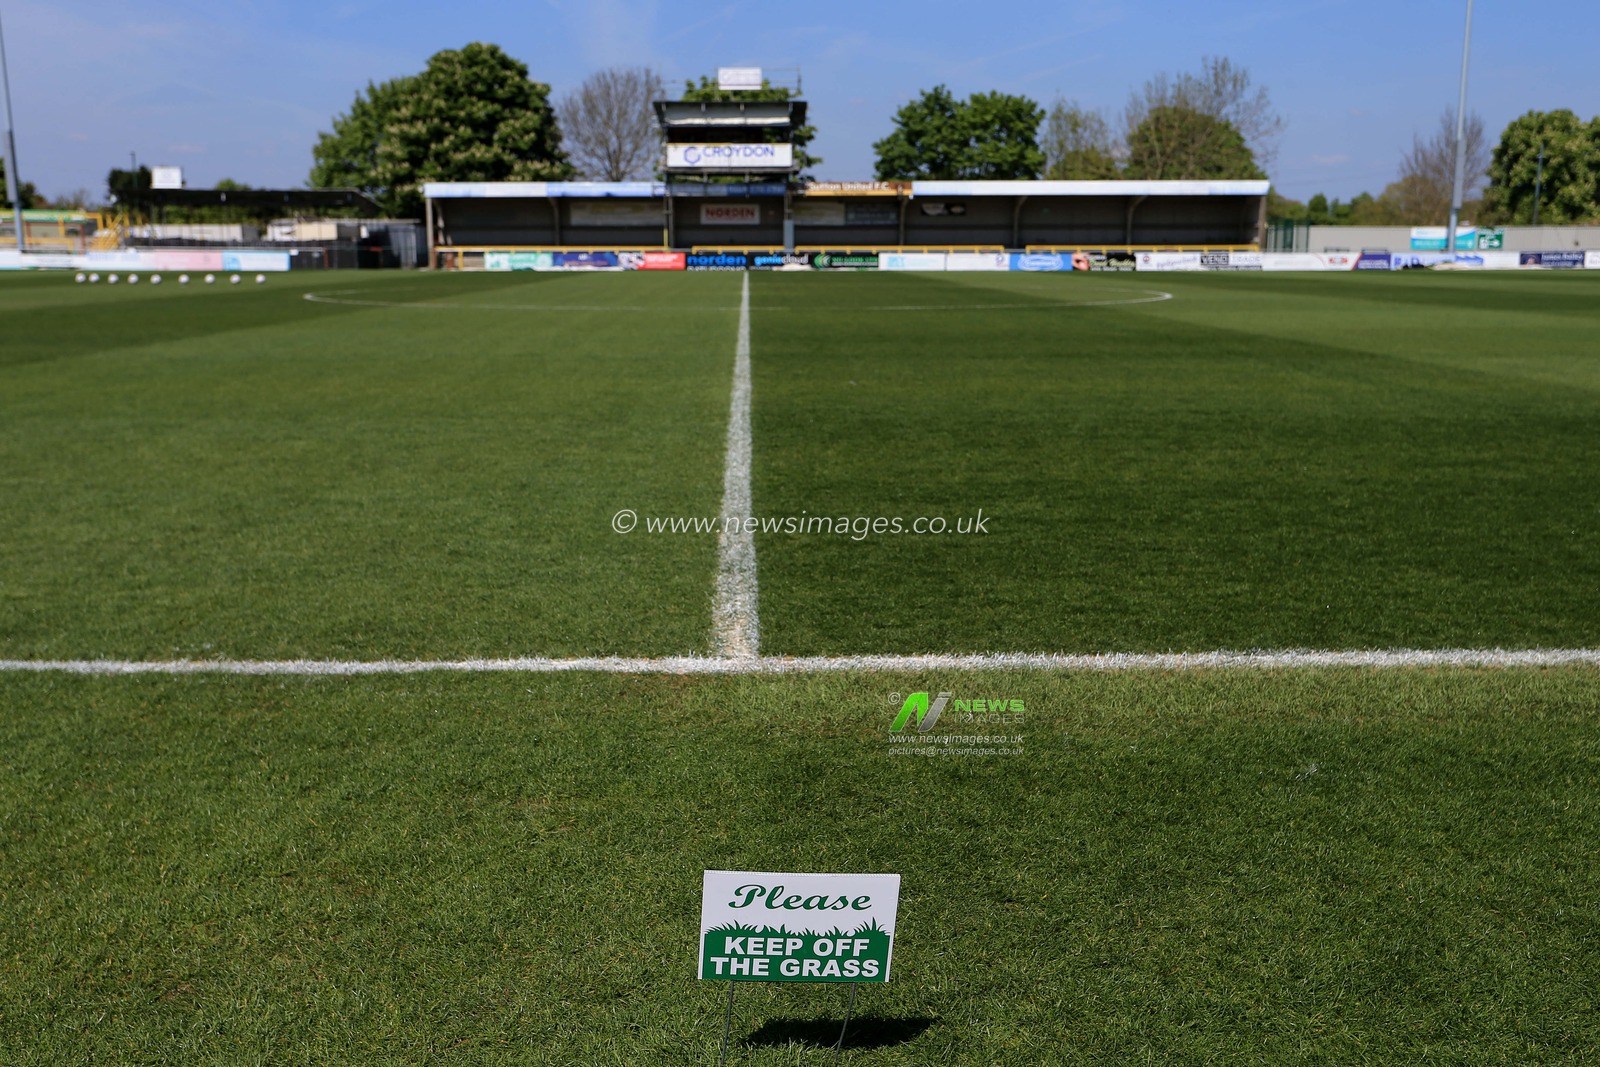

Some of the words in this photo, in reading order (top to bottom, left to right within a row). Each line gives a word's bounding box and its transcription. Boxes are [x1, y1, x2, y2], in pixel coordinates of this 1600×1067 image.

[703, 147, 775, 158] CROYDON
[809, 182, 841, 191] Sutton
[705, 207, 756, 218] NORDEN
[687, 254, 747, 266] norden
[728, 884, 872, 911] Please
[724, 937, 803, 956] KEEP
[813, 938, 870, 957] OFF
[710, 956, 770, 976] THE
[780, 958, 879, 978] GRASS
